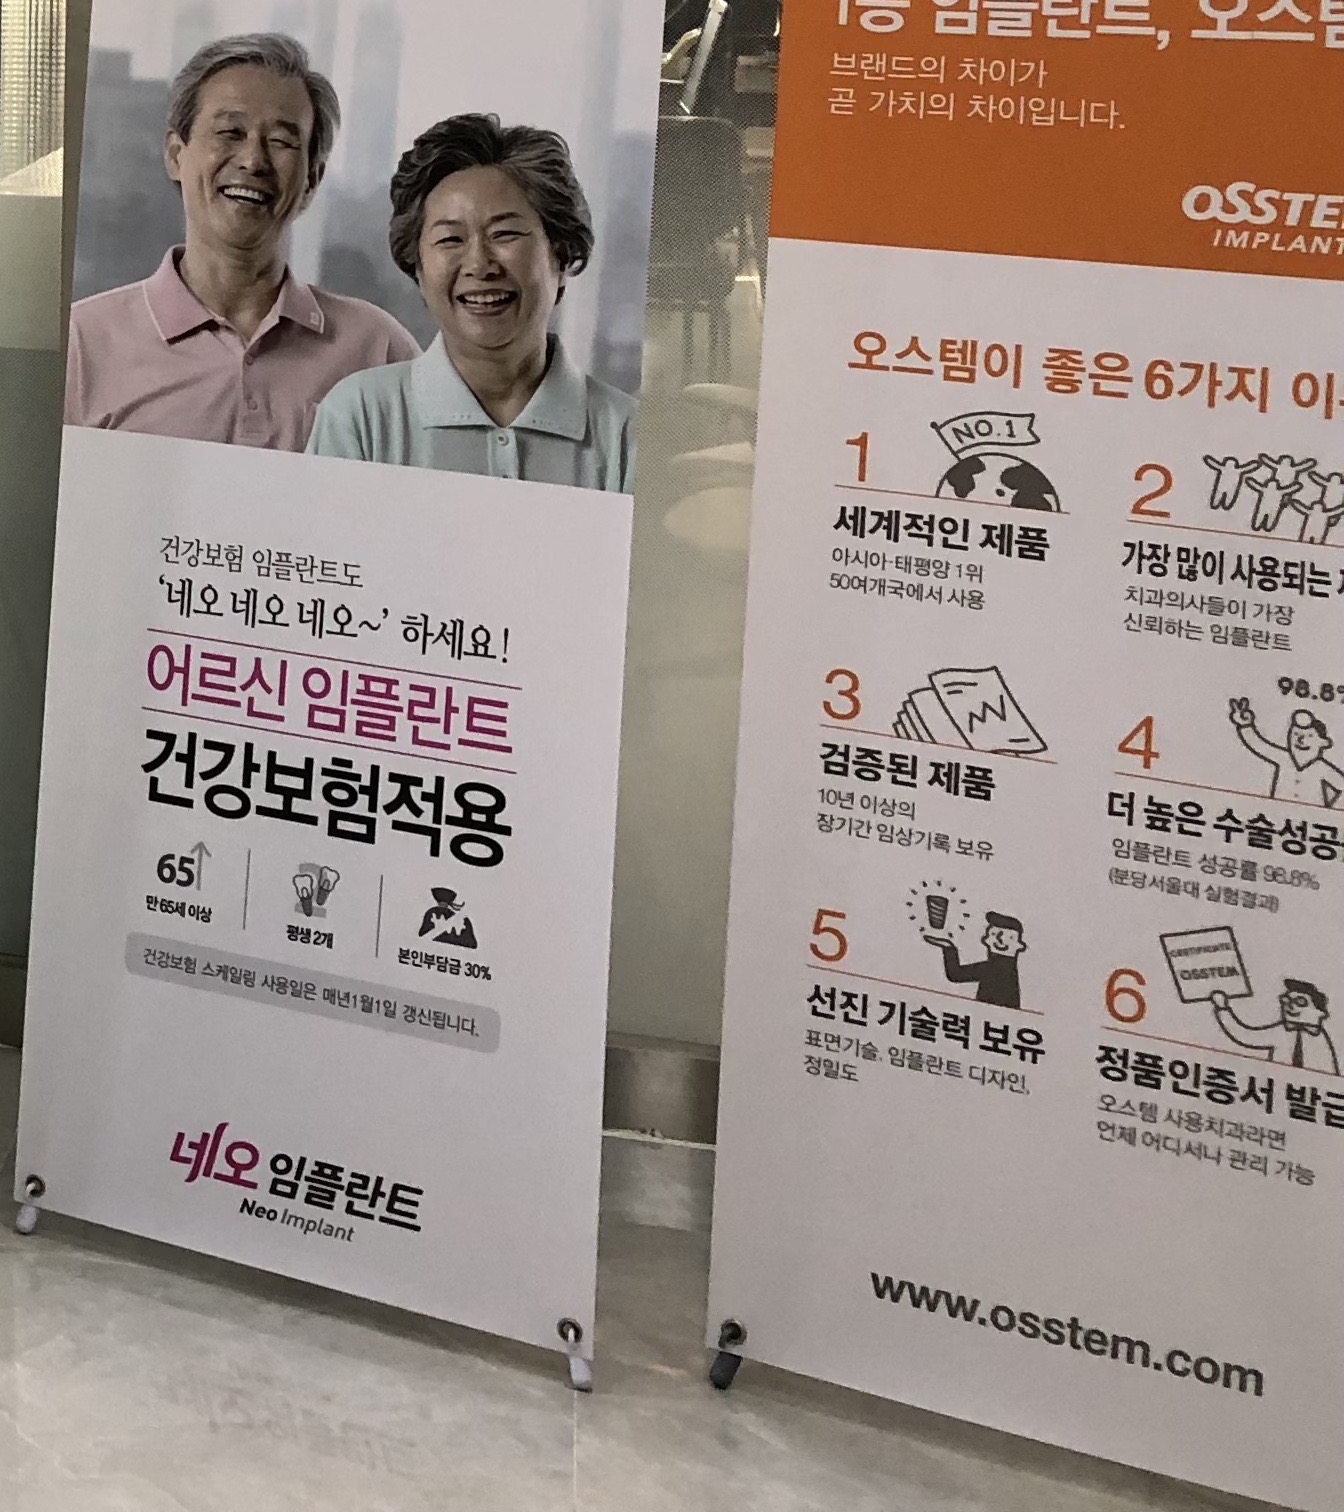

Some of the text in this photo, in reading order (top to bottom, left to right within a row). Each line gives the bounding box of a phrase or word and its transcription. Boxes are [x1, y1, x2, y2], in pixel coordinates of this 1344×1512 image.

[829, 53, 1048, 89] 브랜드의 차이가
[828, 88, 1126, 130] 곧 가치의 차이입니다.
[1181, 181, 1344, 229] OSSTE
[847, 330, 1344, 420] 오스템이 좋은 6가지 이
[845, 432, 869, 482] 1
[1131, 463, 1173, 519] 2
[833, 504, 1050, 561] 세계적인 제품
[159, 536, 363, 587] 건강보험 임플란트도
[956, 561, 984, 584] 1위
[1121, 540, 1171, 577] 가장
[1176, 547, 1225, 583] 많이
[1230, 554, 1333, 598] 사용되는
[829, 573, 985, 611] 50여개국에서 사용
[1124, 585, 1294, 626] 치과의사들이 가장
[231, 587, 509, 662] 네오 하세요!
[1123, 612, 1293, 653] 신뢰하는 임플란트
[147, 643, 512, 753] 어르신 임플란트
[821, 668, 862, 721] 3
[1117, 715, 1160, 769] 4
[141, 728, 512, 867] 건강보험적용
[818, 742, 996, 802] 검증된 제품
[817, 813, 994, 861] 장기간 임상기록 보유
[1107, 791, 1344, 862] 더 높은 수술성공
[157, 853, 196, 887] 65
[1108, 867, 1200, 900] (분당서울대
[1112, 838, 1320, 892] 임플란트 성공률 98.8%
[286, 924, 334, 949] 평생 2개
[810, 909, 848, 962] 5
[398, 947, 492, 981] 본인부담금 30%
[1180, 964, 1240, 983] OSSTEM
[143, 948, 479, 1037] 건강보험 스케일링 사용일은 매년1월1일 갱신됩니다.
[1104, 968, 1147, 1024] 6
[806, 984, 1045, 1066] 선진 기술력 보유
[804, 1053, 859, 1083] 정밀도
[887, 1045, 963, 1079] 임플란트
[1095, 1044, 1274, 1115] 정품인증서
[1097, 1094, 1287, 1151] 오스템 사용치과라면
[170, 1122, 423, 1232] 네오 임플란트
[239, 1197, 355, 1243] Neo Implant
[869, 1271, 1264, 1397] www.osstem.com
